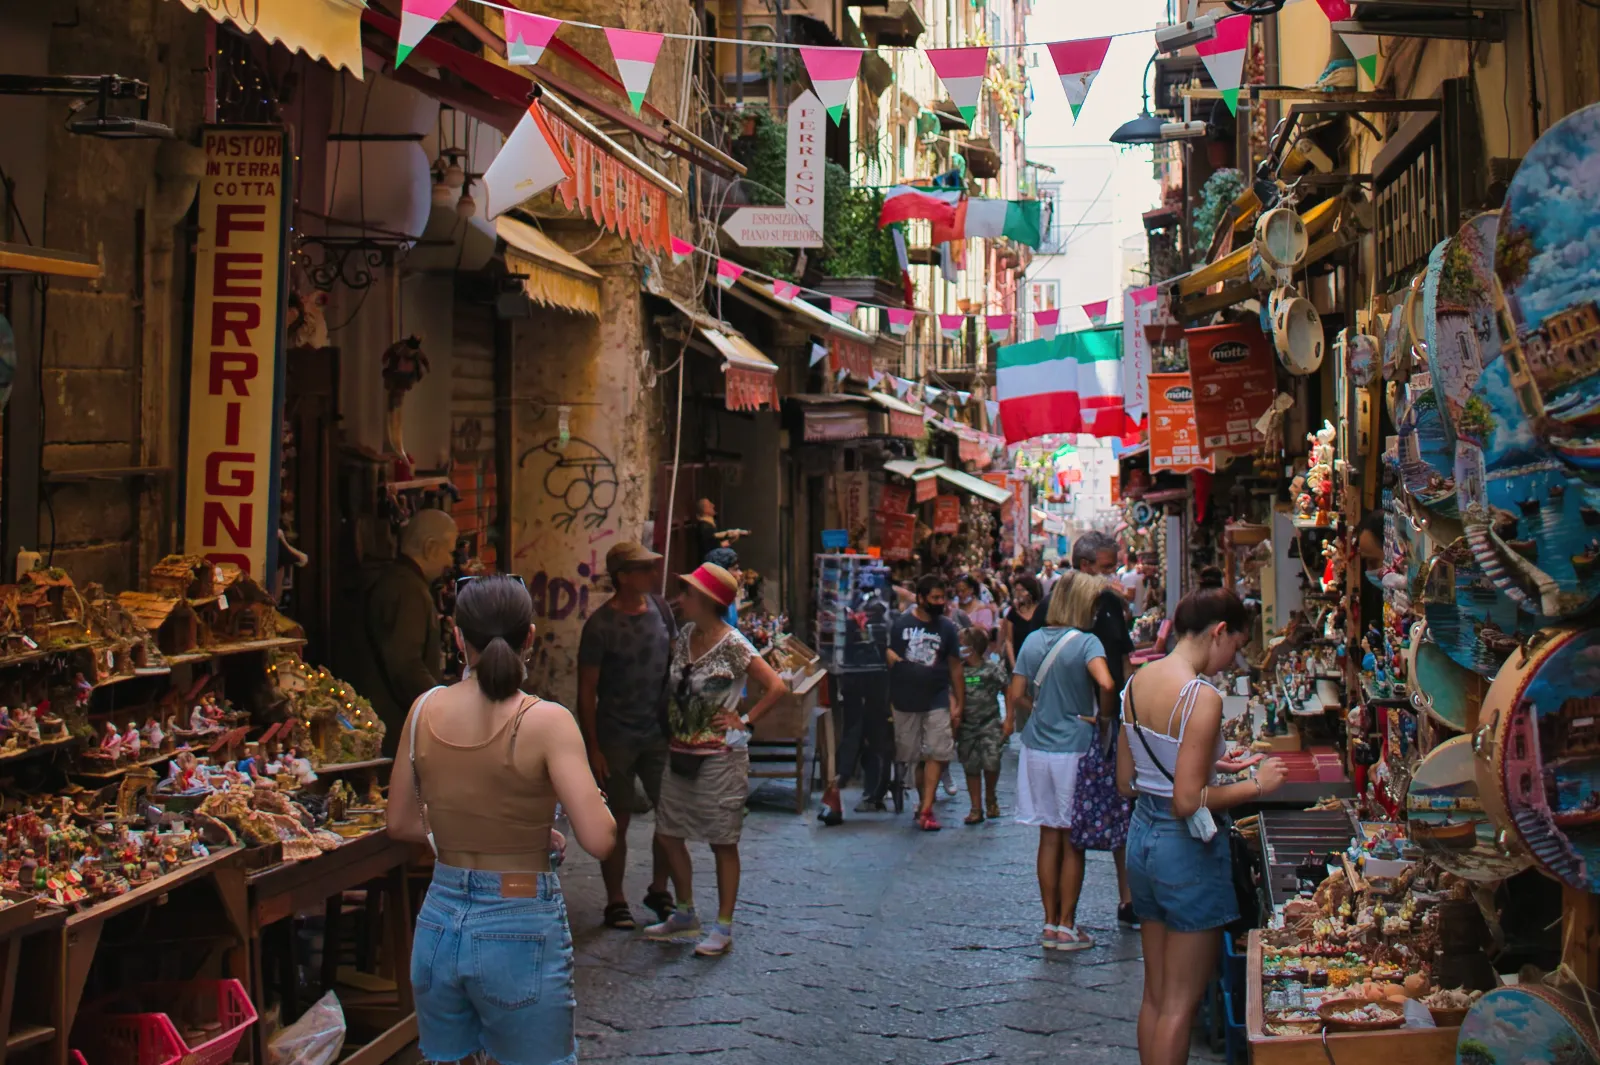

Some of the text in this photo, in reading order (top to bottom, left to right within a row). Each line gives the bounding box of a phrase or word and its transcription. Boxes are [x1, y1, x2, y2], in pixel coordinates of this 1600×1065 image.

[206, 135, 282, 157] PASTORI
[795, 108, 815, 206] FERRIGNO
[206, 161, 281, 177] IN TERRA
[213, 182, 276, 197] COTTA
[752, 213, 811, 226] ESPOSIZIONE
[1376, 144, 1440, 281] FERRARA
[741, 229, 822, 242] PIANO SUPERIORE
[1212, 347, 1250, 360] motta
